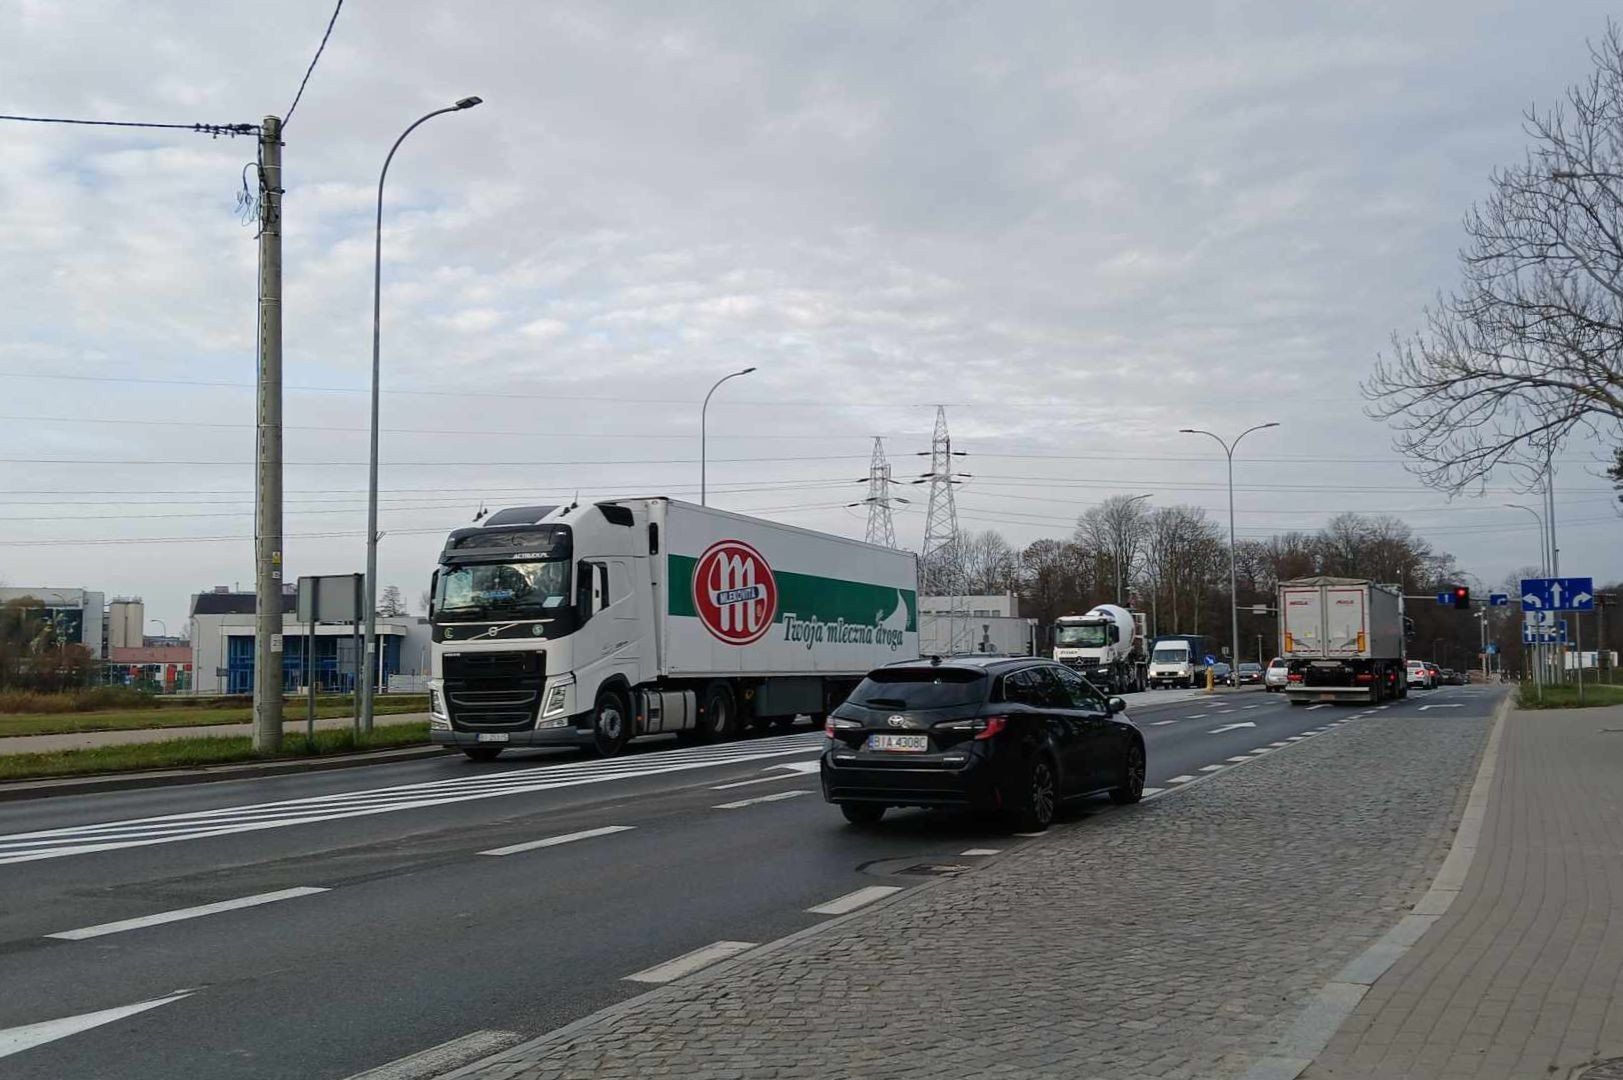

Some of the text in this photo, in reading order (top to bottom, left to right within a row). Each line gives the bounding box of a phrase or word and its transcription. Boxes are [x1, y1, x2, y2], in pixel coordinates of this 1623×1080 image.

[784, 615, 824, 650] Twoja
[826, 618, 873, 645] mleczna
[875, 623, 904, 652] droga
